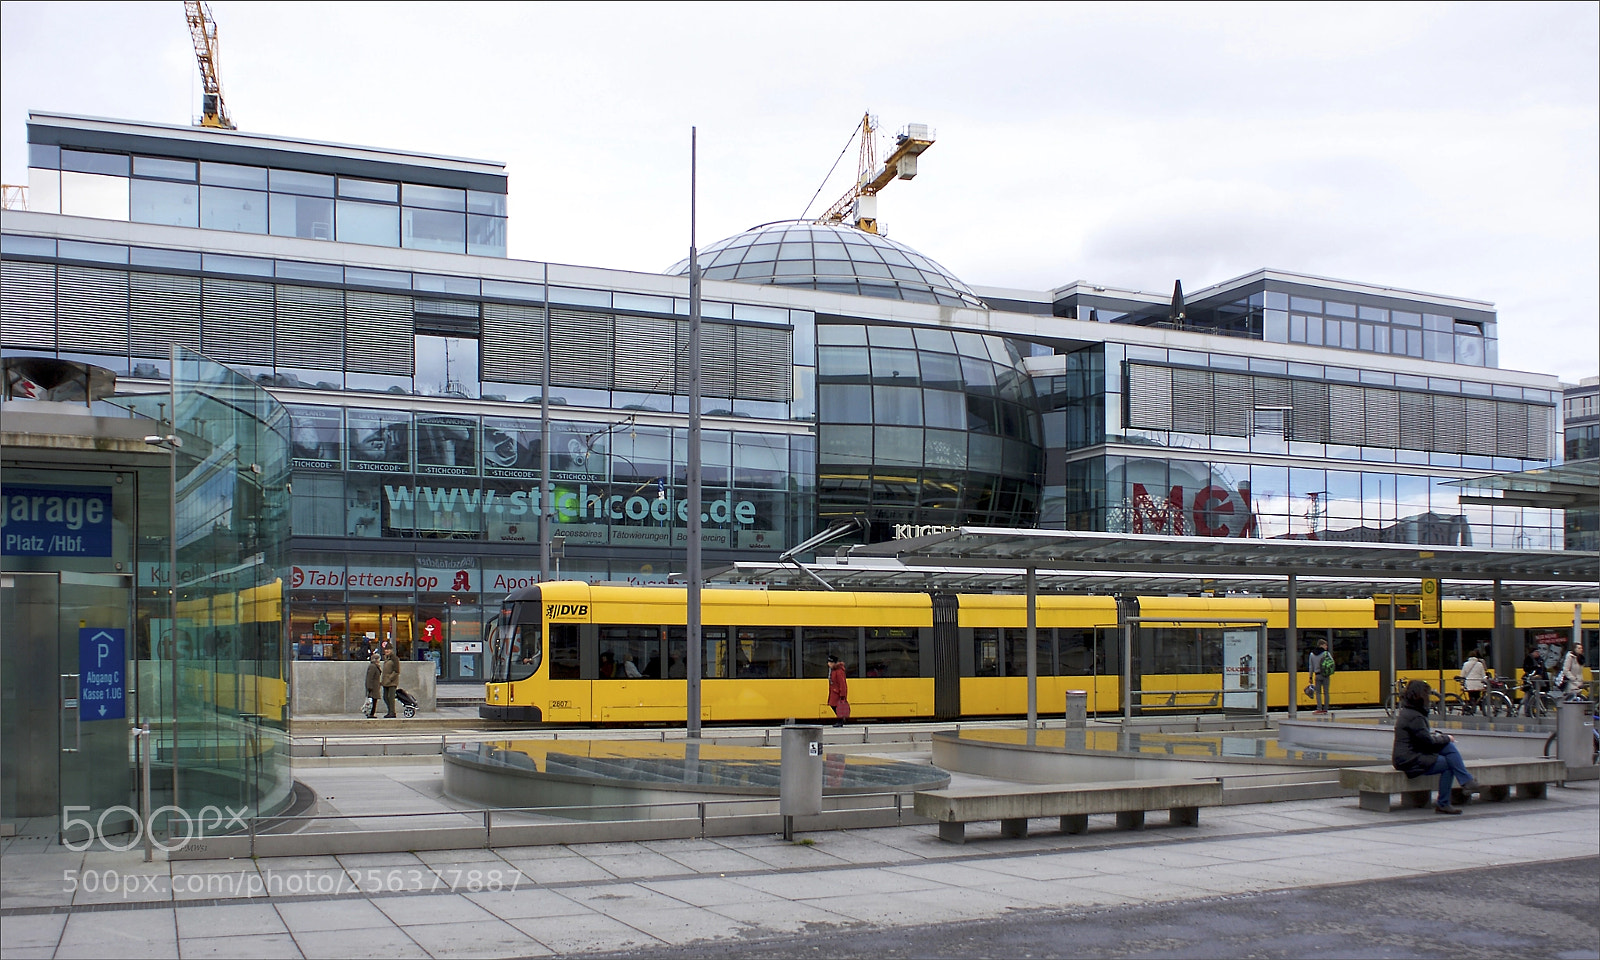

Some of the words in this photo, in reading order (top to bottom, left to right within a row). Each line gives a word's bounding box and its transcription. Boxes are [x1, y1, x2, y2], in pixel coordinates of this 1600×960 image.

[554, 528, 603, 538] Accessoires
[612, 530, 669, 541] Tätowierungen
[6, 534, 44, 551] Platz
[308, 570, 438, 591] Tablettenshop
[560, 604, 588, 616] DVB
[97, 643, 109, 668] P
[86, 671, 113, 686] Abgang
[113, 671, 119, 683] C
[82, 687, 104, 700] Kasse
[106, 687, 122, 700] 1.UG
